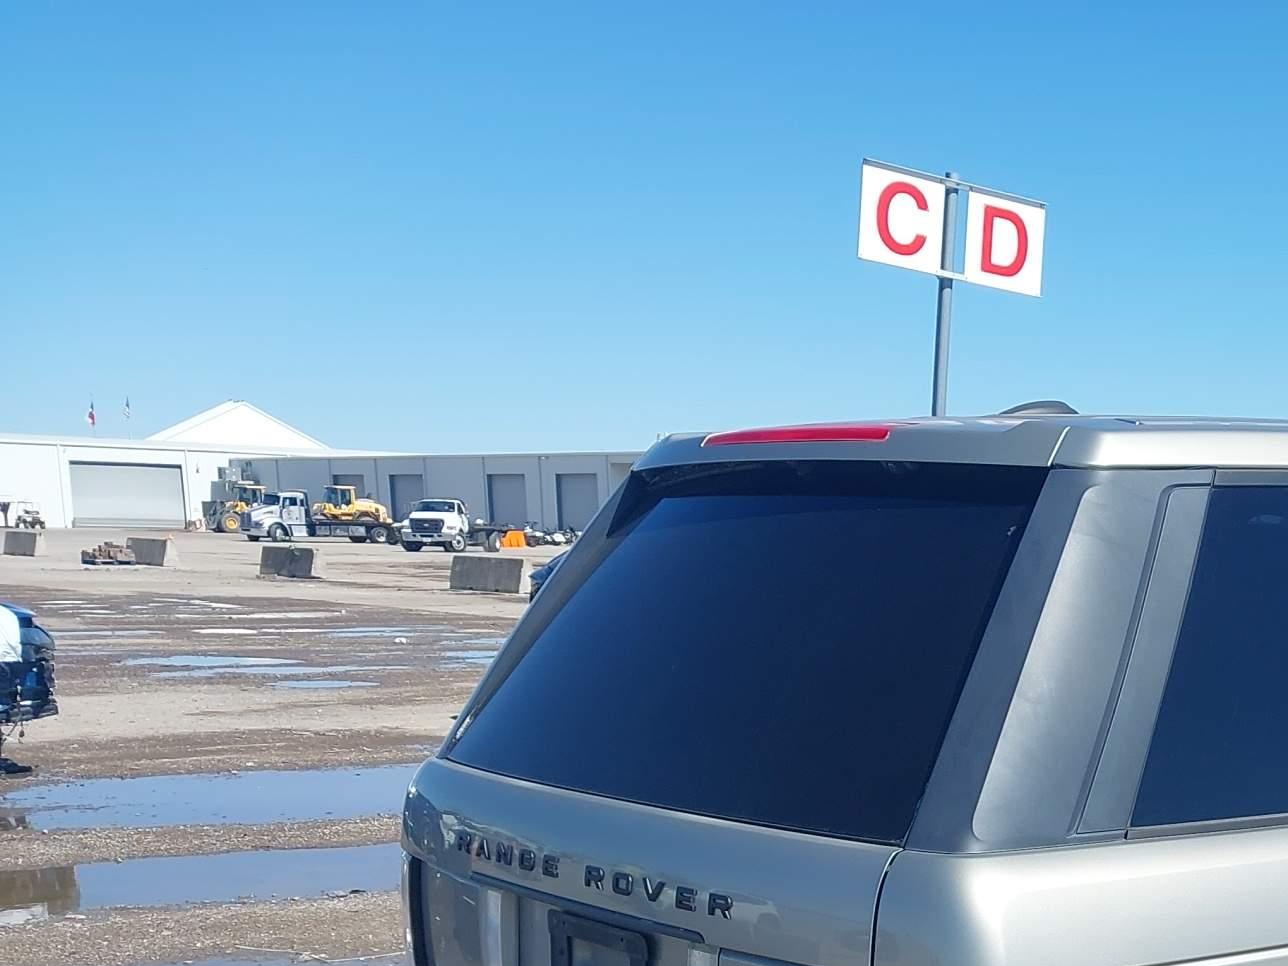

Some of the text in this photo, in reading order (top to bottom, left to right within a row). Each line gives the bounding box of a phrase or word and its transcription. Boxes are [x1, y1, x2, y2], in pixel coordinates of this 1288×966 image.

[876, 181, 929, 256] C
[981, 204, 1029, 278] D
[457, 831, 735, 920] RANGE ROVER
